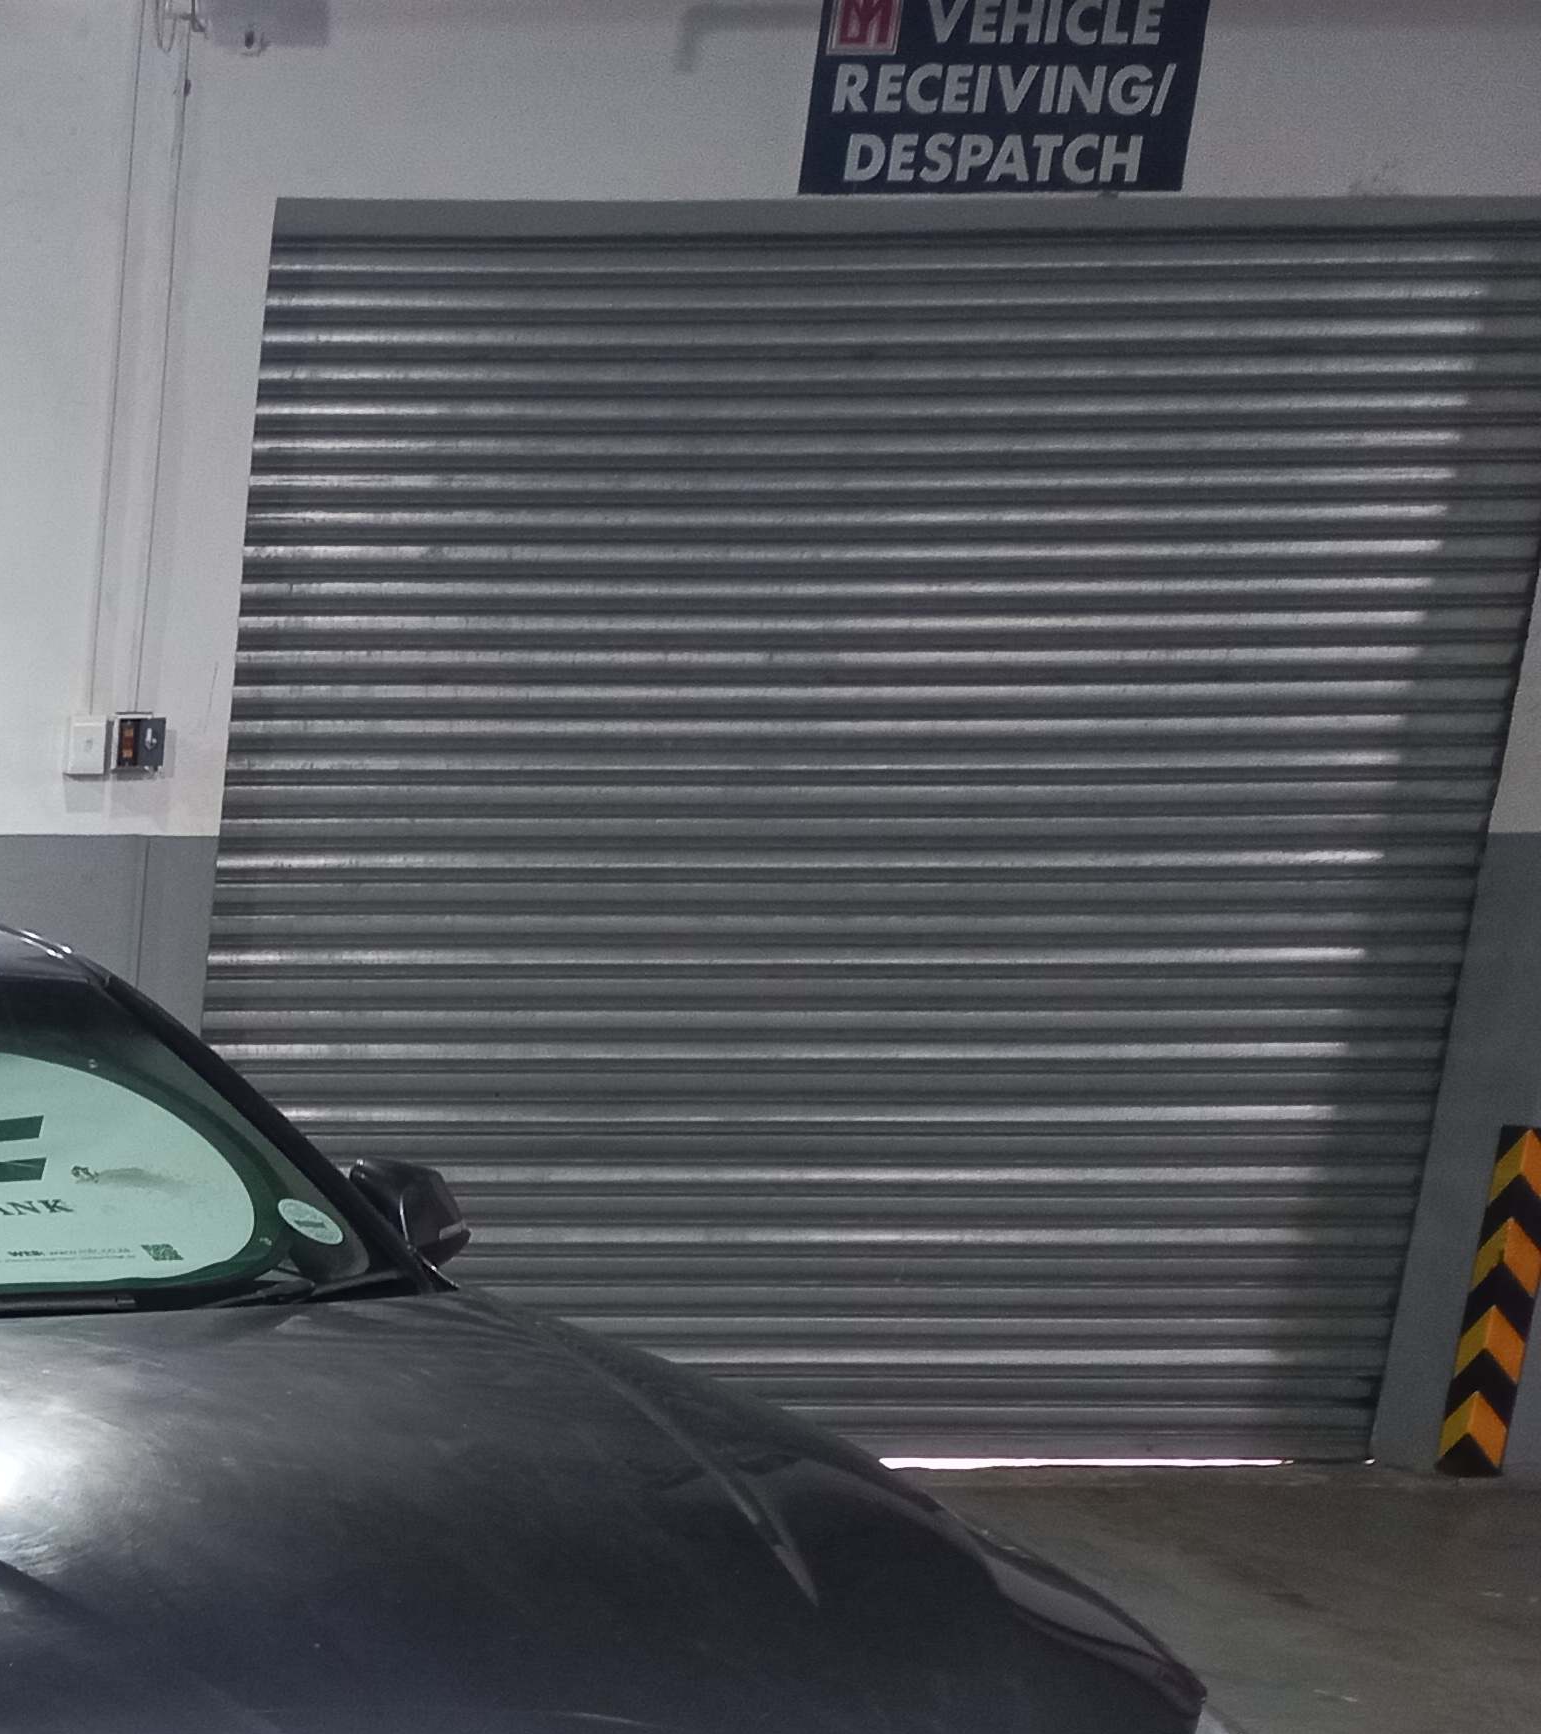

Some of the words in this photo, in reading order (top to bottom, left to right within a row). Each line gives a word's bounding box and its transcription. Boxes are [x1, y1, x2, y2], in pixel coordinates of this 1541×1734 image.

[929, 0, 1164, 46] VEHICLE
[832, 63, 1177, 116] RECEIVING/
[843, 134, 1144, 184] DESPATCH
